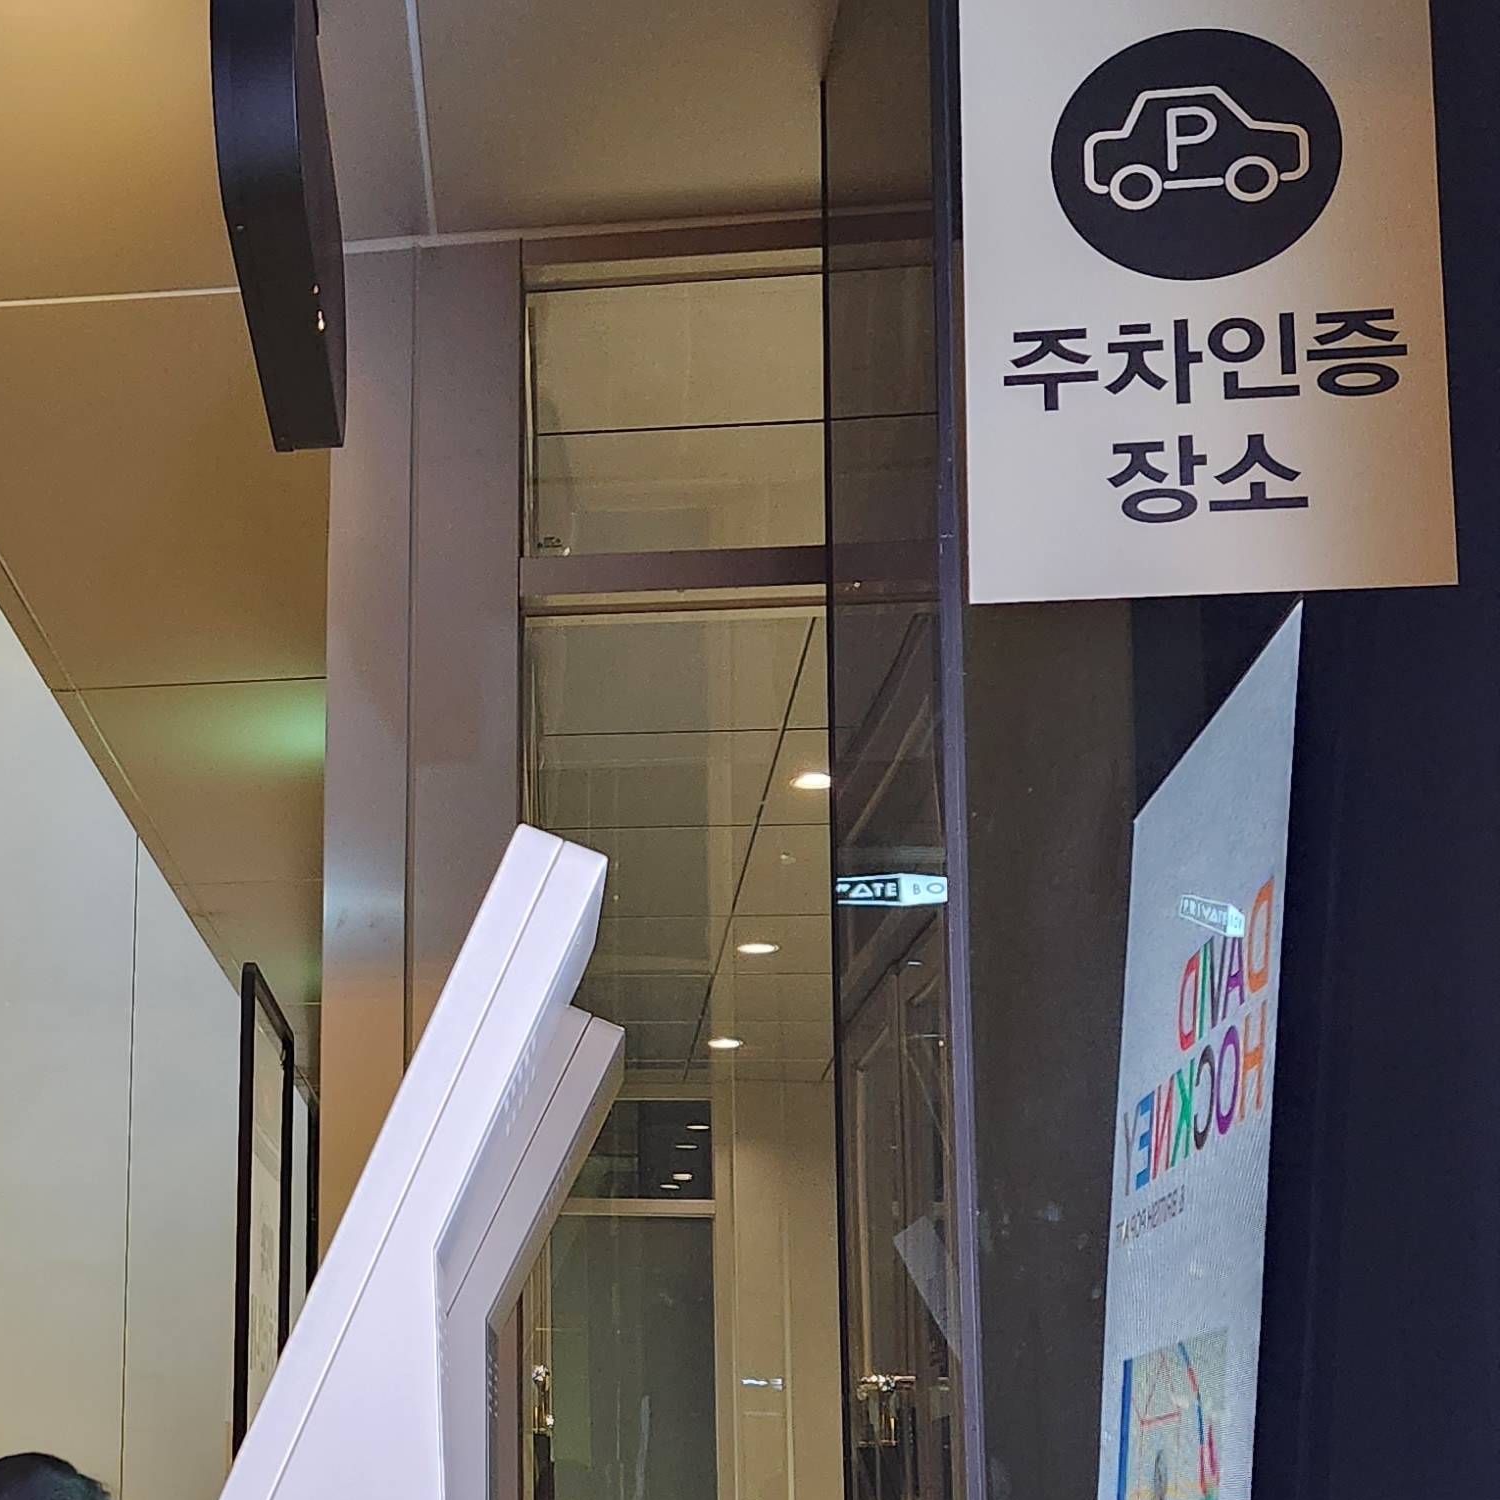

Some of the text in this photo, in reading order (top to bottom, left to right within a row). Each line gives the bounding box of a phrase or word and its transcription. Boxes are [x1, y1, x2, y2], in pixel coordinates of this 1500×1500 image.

[1166, 106, 1217, 172] P
[1003, 308, 1407, 411] 주차인증
[1107, 434, 1308, 523] 장소
